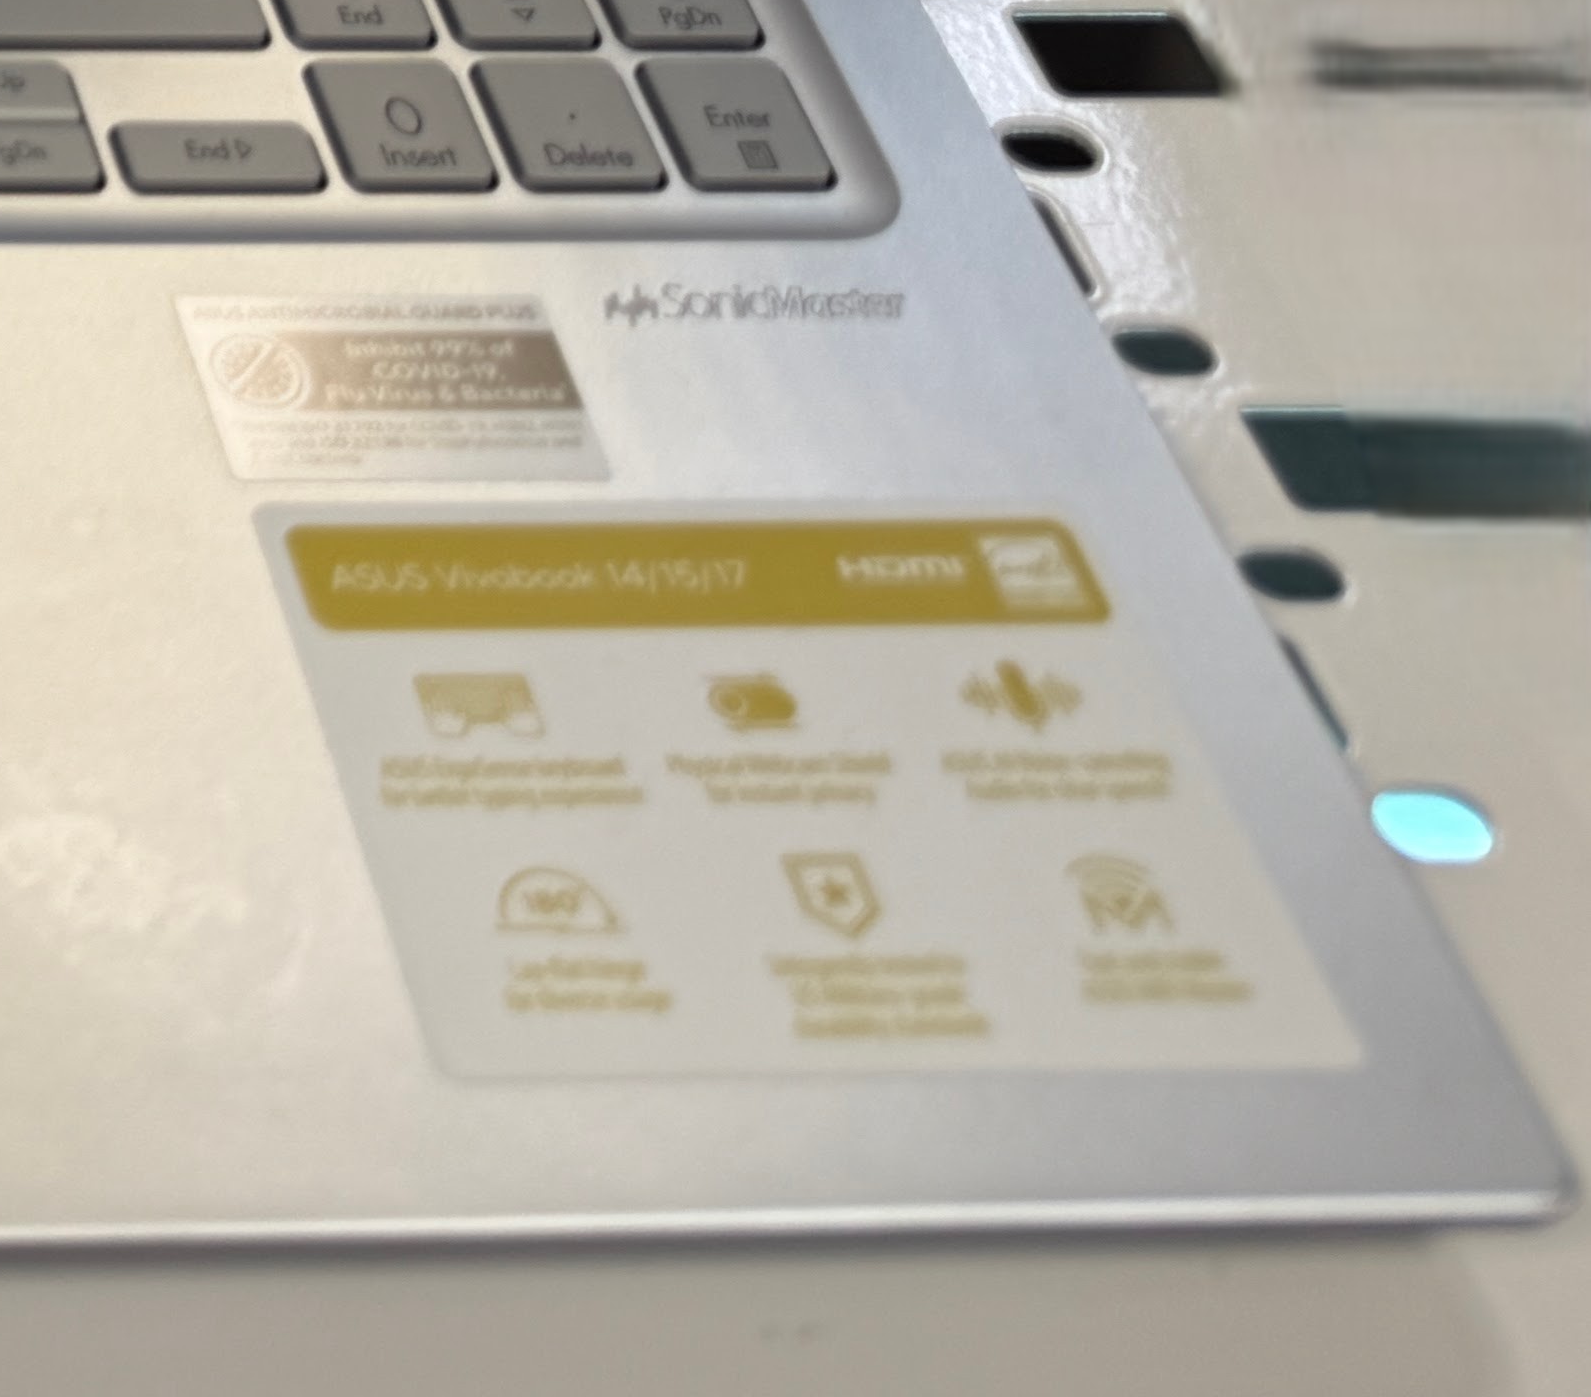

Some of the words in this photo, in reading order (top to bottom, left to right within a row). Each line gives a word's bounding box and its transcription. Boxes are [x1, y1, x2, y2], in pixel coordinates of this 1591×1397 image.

[338, 5, 385, 26] End
[659, 6, 723, 30] PgDn
[704, 104, 772, 130] Enter
[183, 136, 230, 162] End
[380, 143, 459, 169] Insert
[544, 142, 636, 169] Delete
[660, 281, 906, 321] SonicMaster
[331, 560, 429, 592] ASUS
[434, 560, 595, 591] Vivobook
